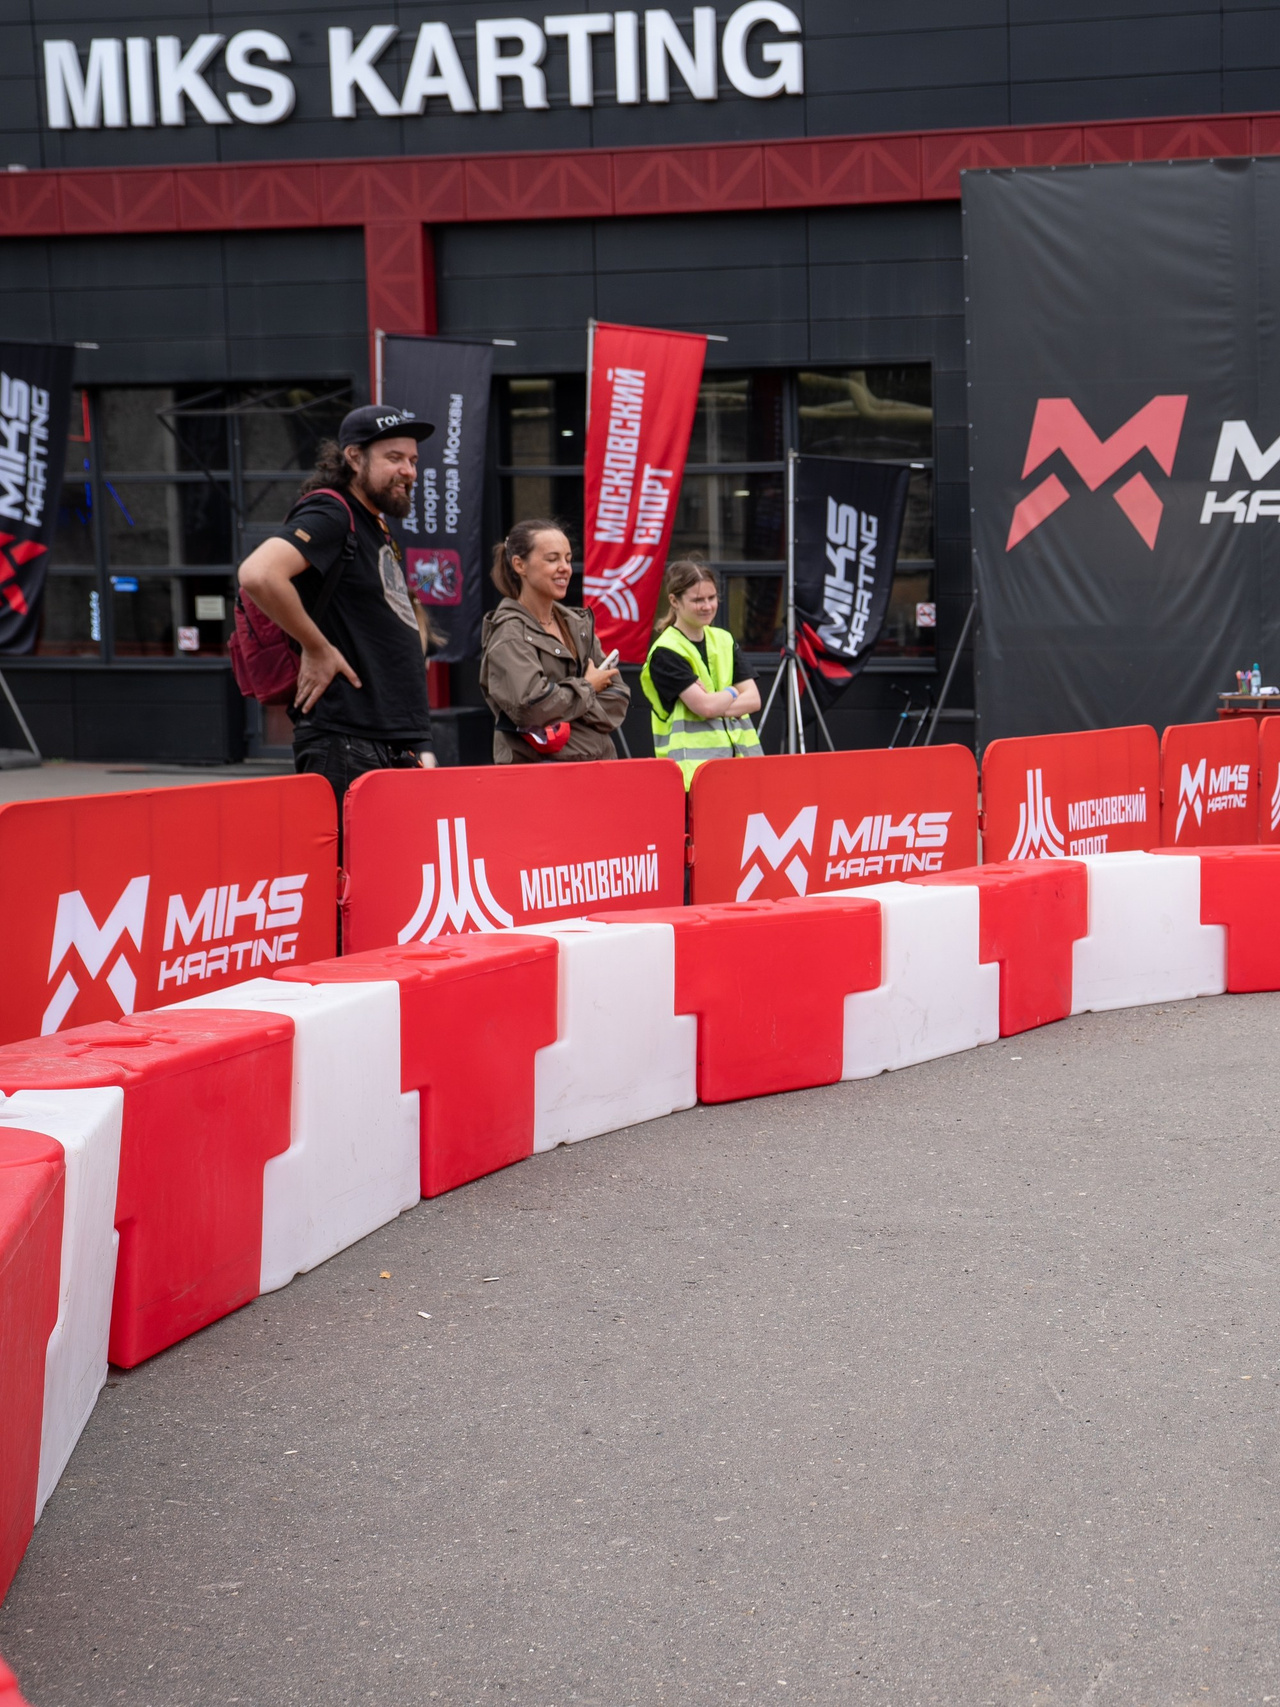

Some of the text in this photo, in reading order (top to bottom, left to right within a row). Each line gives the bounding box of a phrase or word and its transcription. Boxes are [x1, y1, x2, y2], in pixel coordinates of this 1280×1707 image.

[44, 0, 804, 128] MIKS KARTING
[24, 384, 50, 527] KARTING
[443, 394, 463, 534] города Москвы
[594, 367, 646, 544] МОСКОВСКИЙ
[423, 468, 440, 534] спорта
[632, 463, 673, 545] СПОРТ
[816, 495, 858, 650] MIKS
[843, 511, 878, 657] KARTING
[1068, 787, 1147, 832] МОСКОВСКИЙ
[1207, 794, 1247, 814] KARTING
[1209, 764, 1250, 795] MIKS
[825, 851, 945, 882] KARTING
[829, 812, 952, 857] MIKS
[163, 873, 309, 951] MIKS
[520, 844, 659, 911] МОСКОВСКИЙ
[157, 932, 299, 991] KARTING
